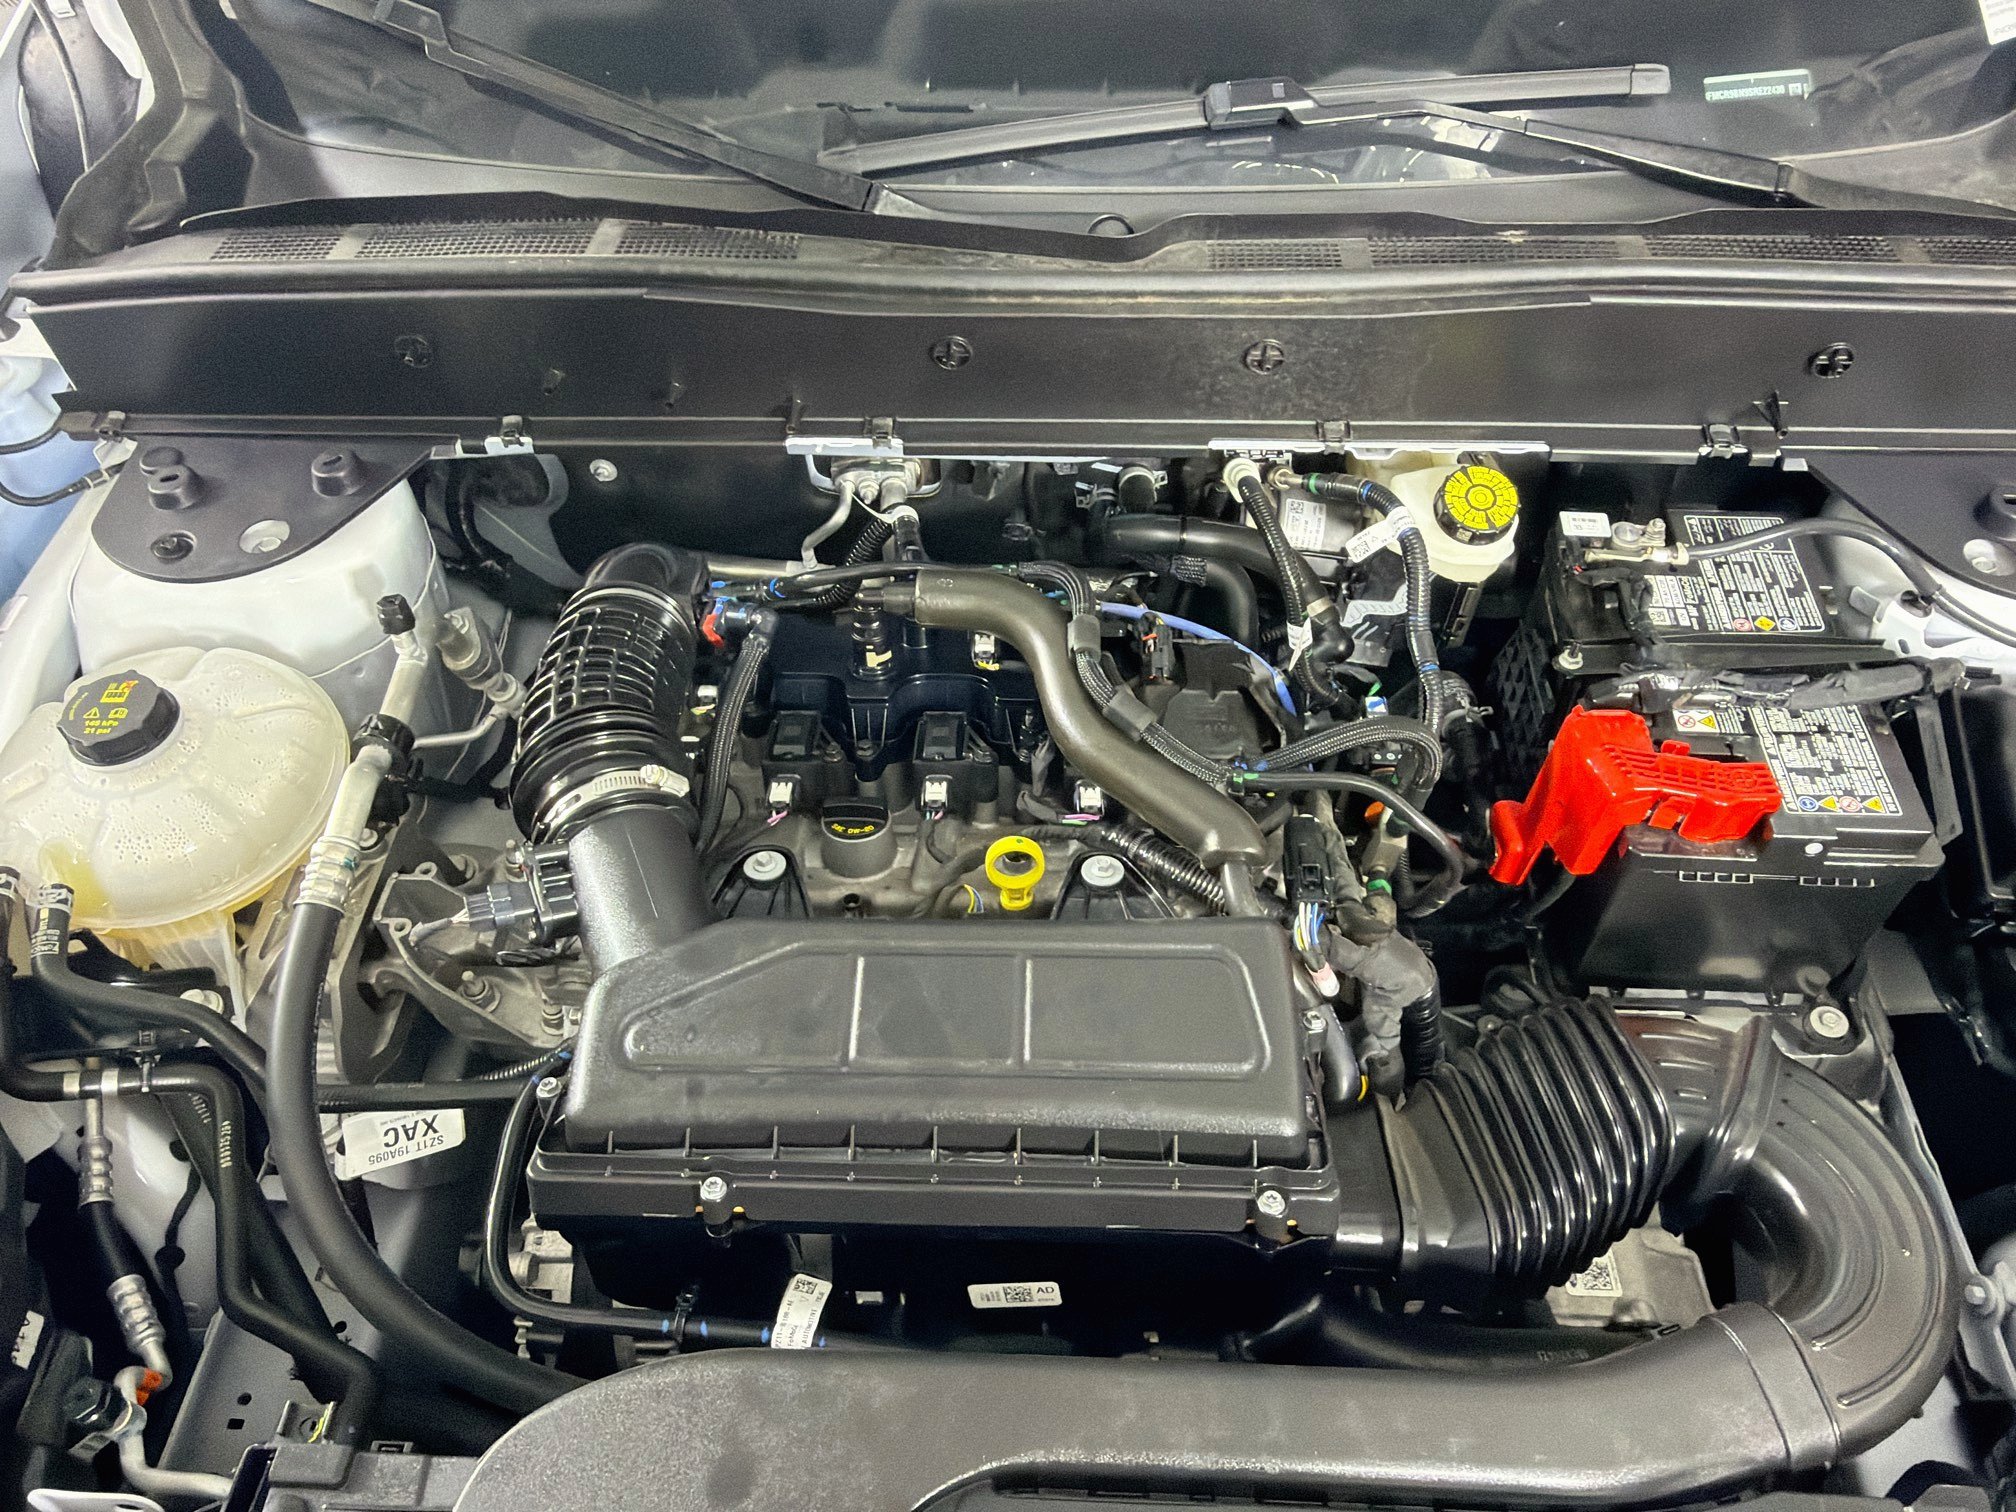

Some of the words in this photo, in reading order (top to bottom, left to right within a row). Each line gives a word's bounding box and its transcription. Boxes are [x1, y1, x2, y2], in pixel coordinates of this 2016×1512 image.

[383, 1113, 440, 1148] XAC
[416, 1135, 444, 1152] SZ1T
[368, 1145, 410, 1165] 19A095
[1036, 1286, 1055, 1294] AD
